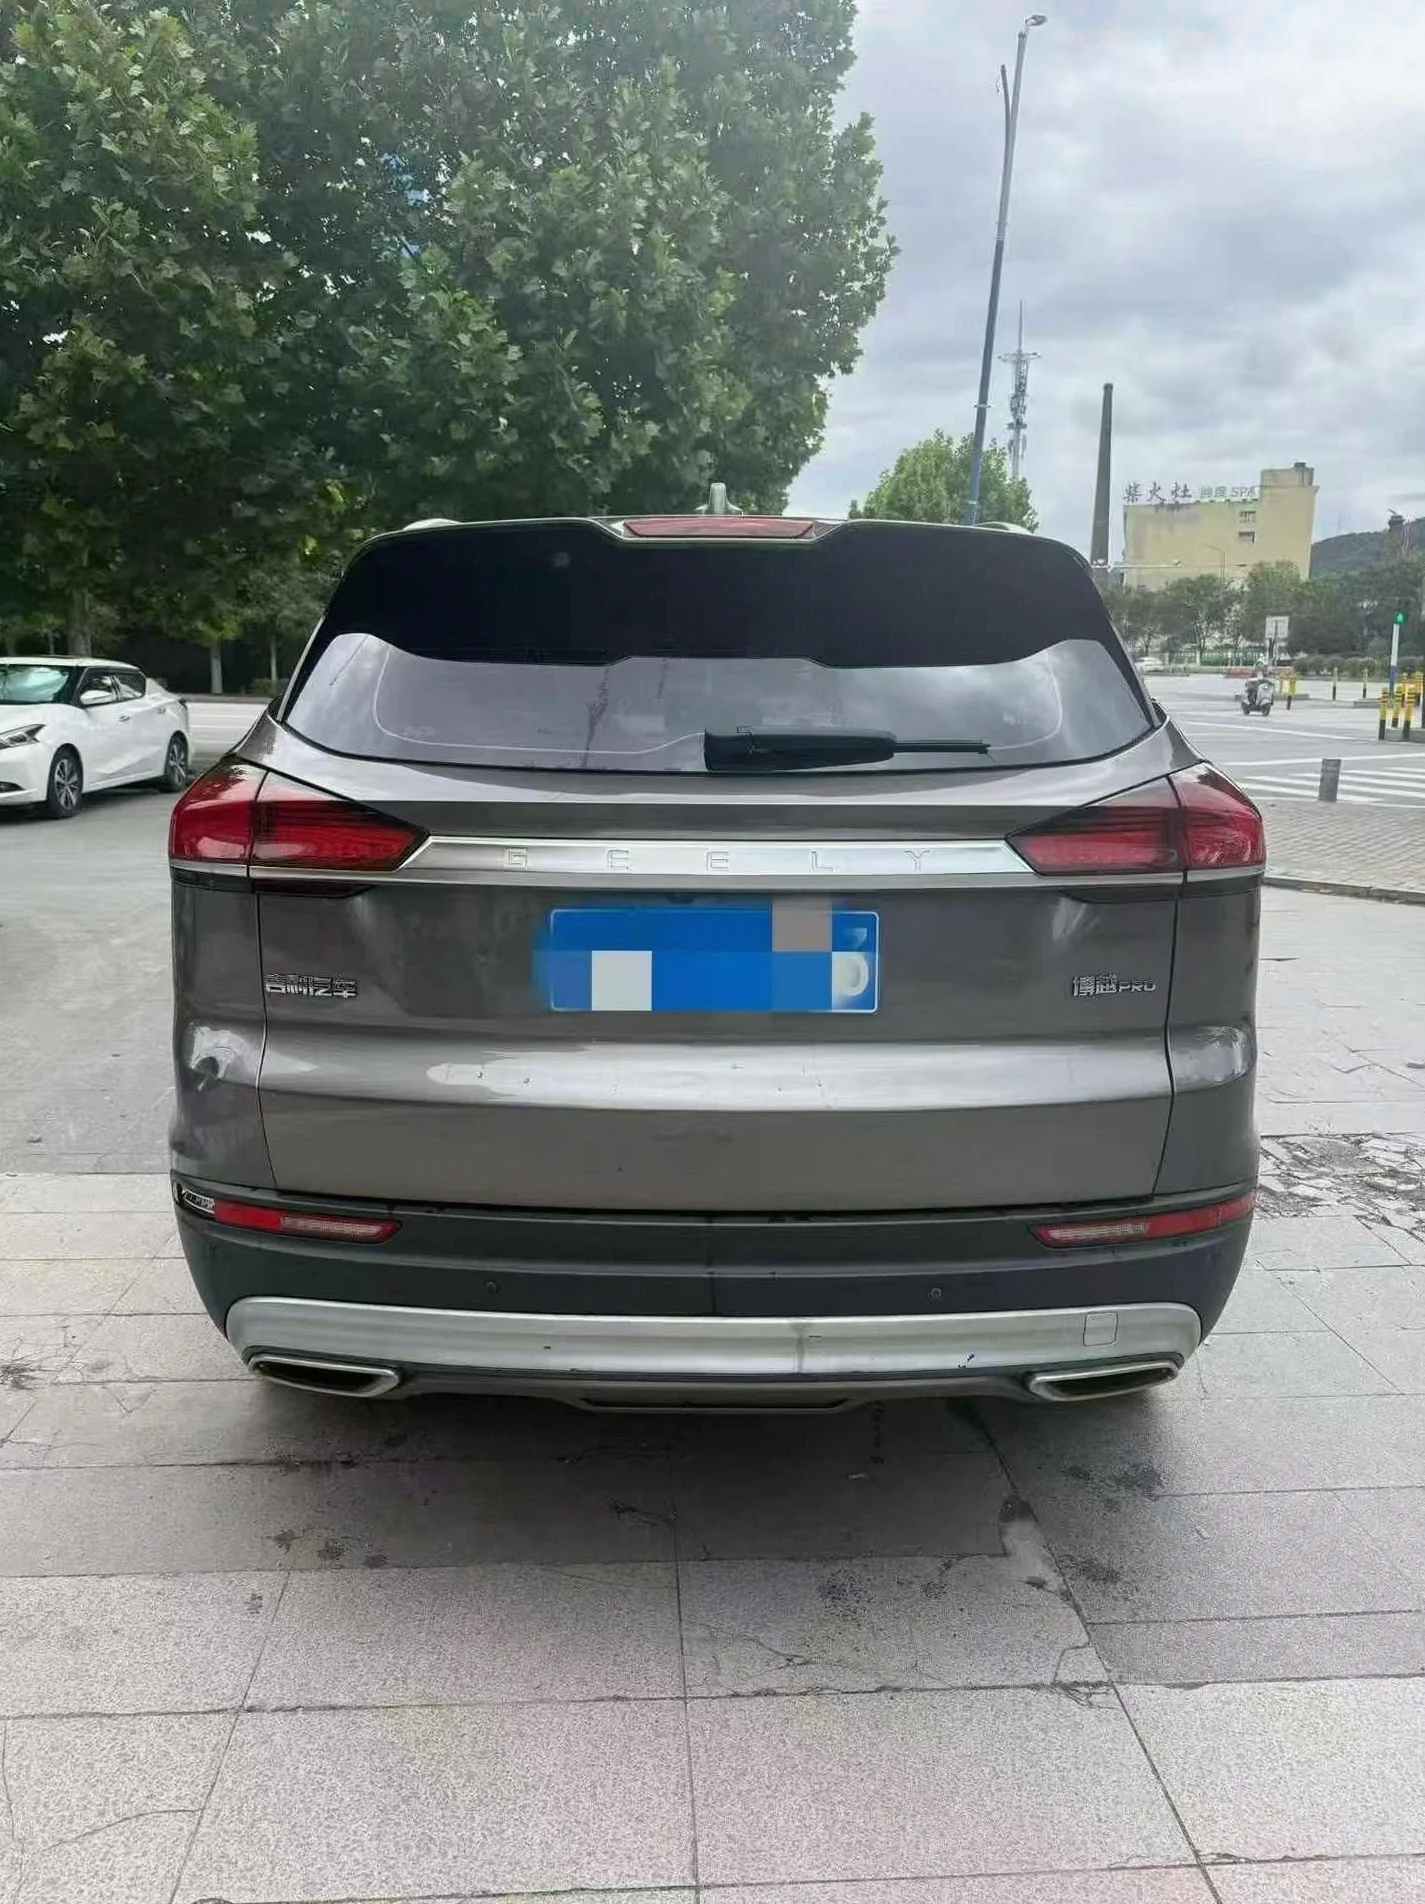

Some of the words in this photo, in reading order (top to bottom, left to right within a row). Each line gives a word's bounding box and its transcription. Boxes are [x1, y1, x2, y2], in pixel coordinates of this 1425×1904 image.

[1122, 481, 1193, 503] 柴火灶
[504, 846, 931, 873] GEELY
